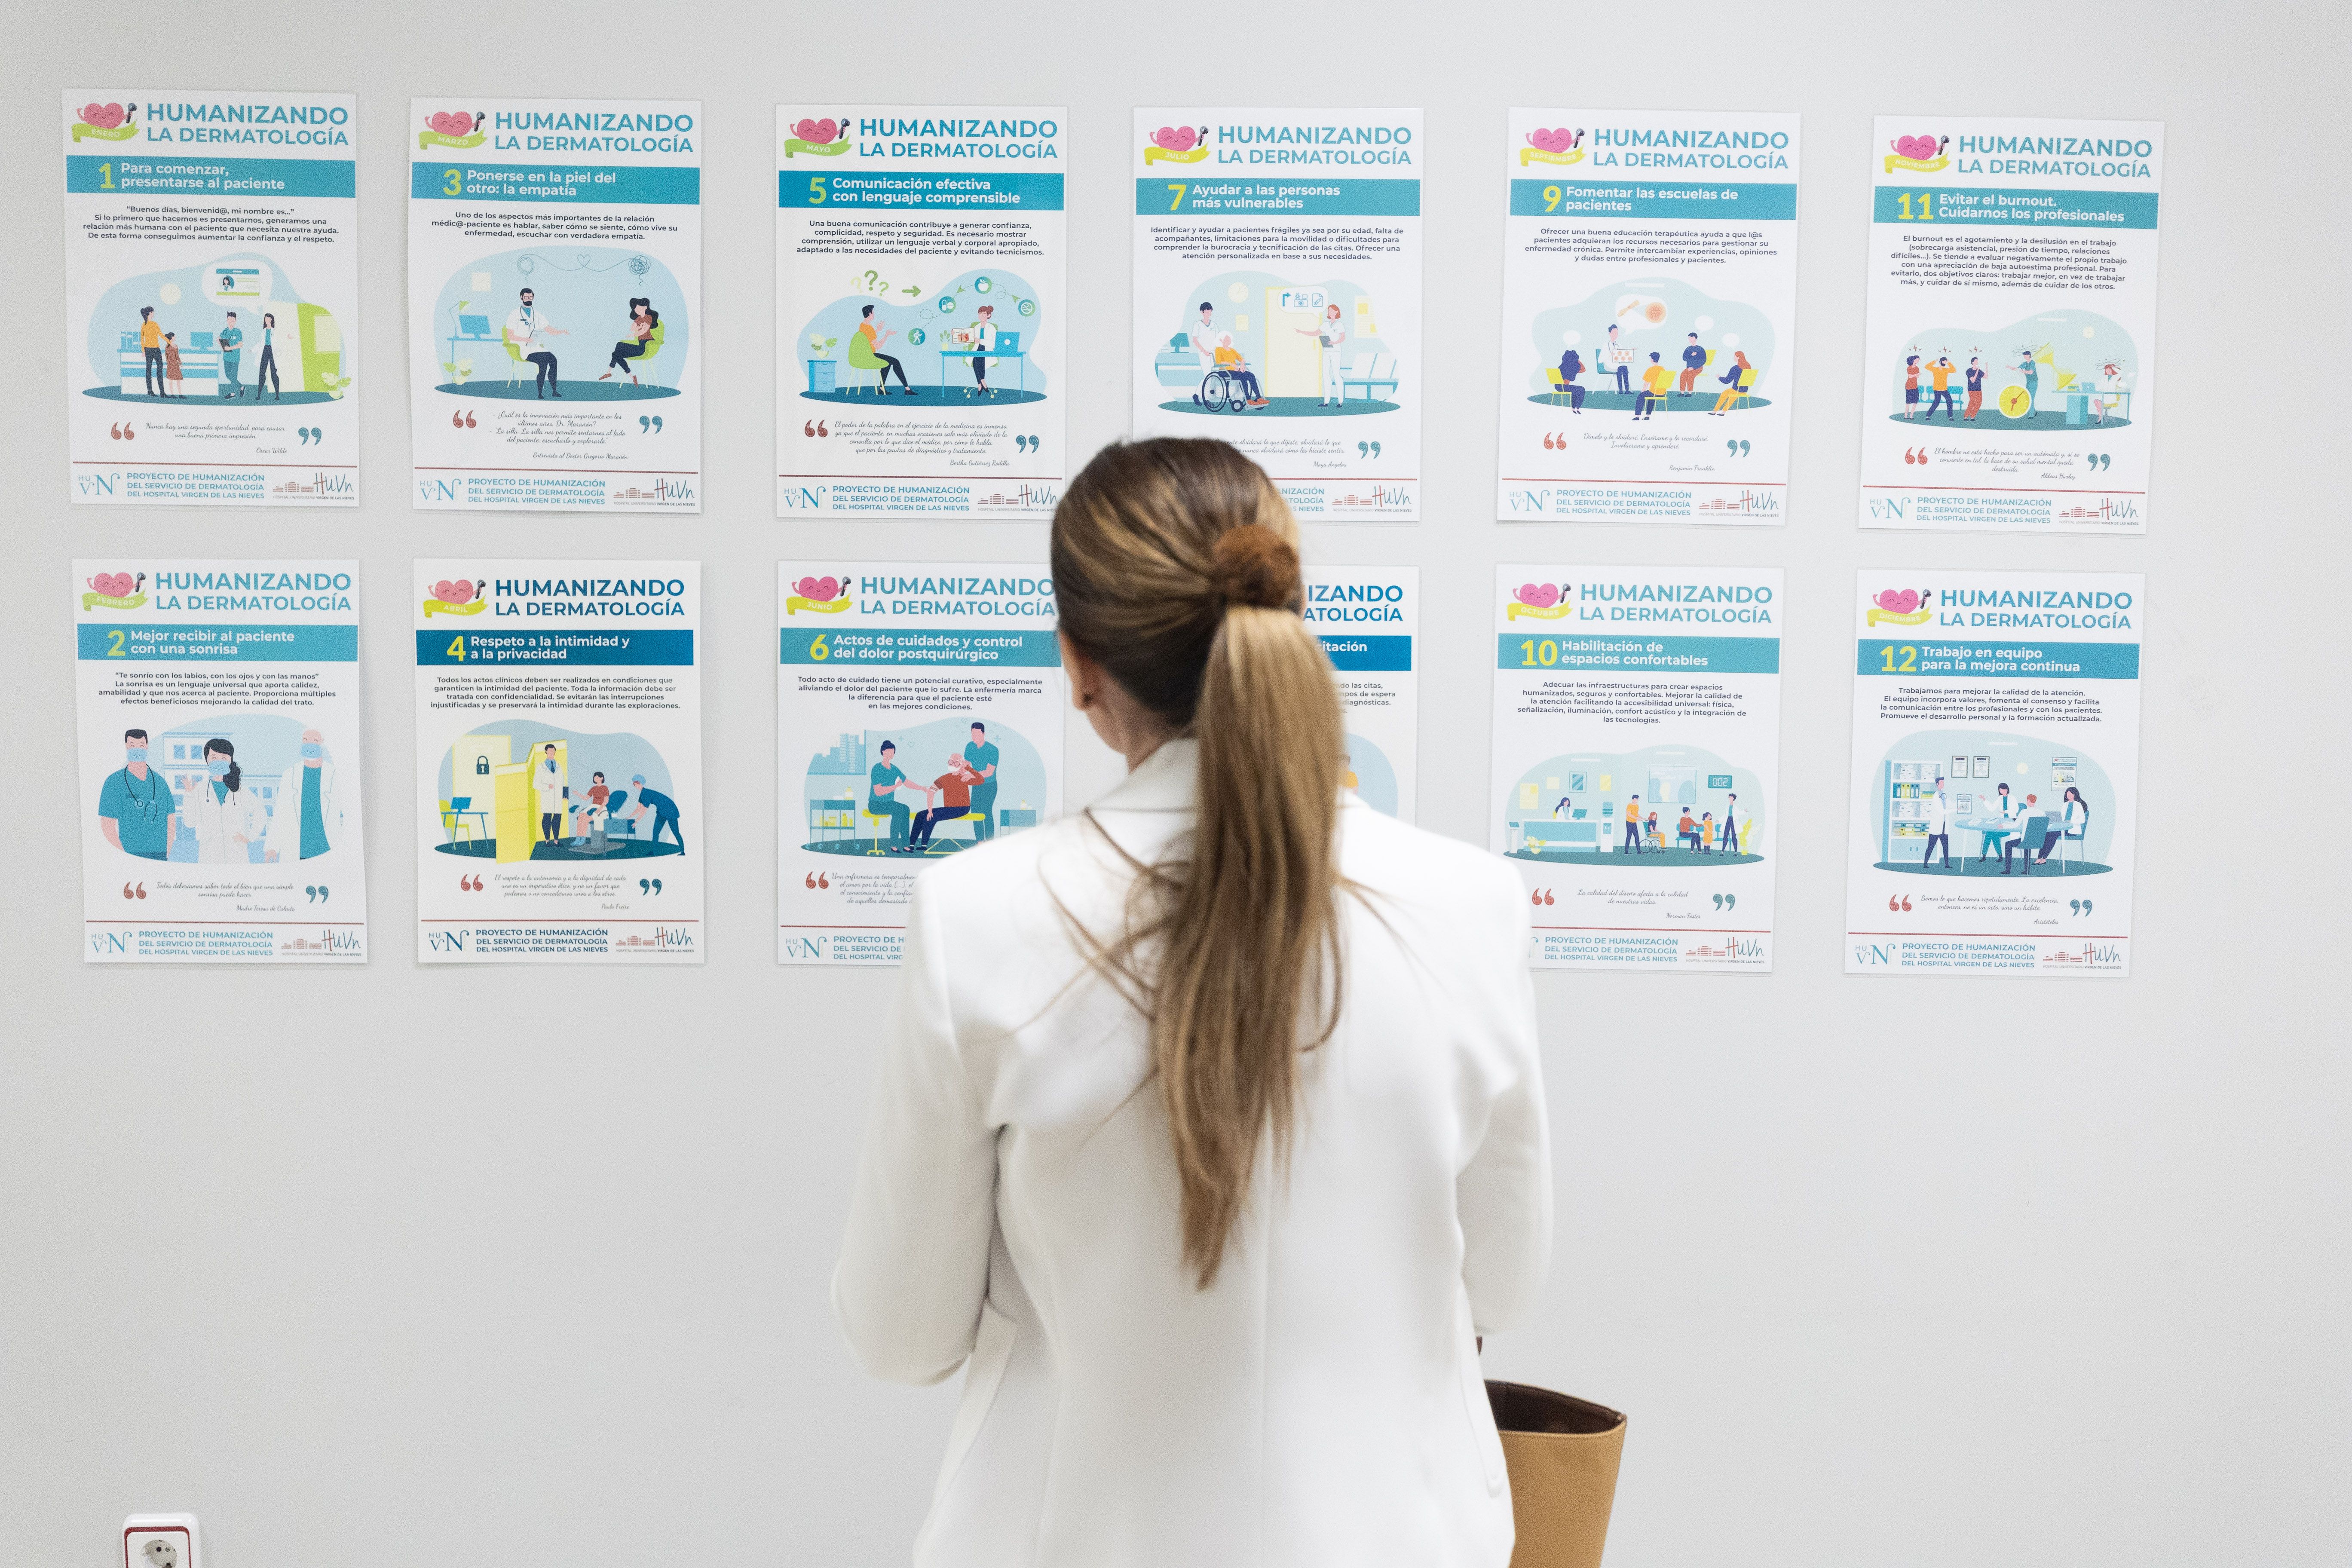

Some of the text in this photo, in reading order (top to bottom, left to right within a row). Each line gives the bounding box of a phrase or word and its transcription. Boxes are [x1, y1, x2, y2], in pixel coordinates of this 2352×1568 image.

[91, 128, 120, 138] ENERO
[860, 118, 1057, 138] HUMANIZANDO
[438, 136, 469, 146] MARZO
[806, 144, 831, 153] MAYO
[860, 140, 1057, 159] LA DERMATOLOGÍA
[1165, 151, 1190, 161] JULIO
[1530, 152, 1577, 162] SEPTIEMBRE
[121, 162, 229, 177] Para comenzar,
[1895, 159, 1940, 169] NOVIEMBRE
[99, 162, 116, 189] 1
[443, 168, 462, 196] 3
[467, 169, 616, 187] Ponerse en la piel del
[121, 177, 285, 191] presentarse al paciente
[466, 183, 577, 198] otro: la empatía
[808, 177, 827, 204] 5
[832, 177, 991, 190] Comunicación efectiva
[1192, 184, 1341, 198] Ayudar a las personas
[832, 190, 1021, 205] con lenguaje comprensible
[1168, 184, 1187, 211] 7
[1543, 185, 1562, 212] 9
[1566, 186, 1739, 200] Fomentar las escuelas de
[1939, 193, 2057, 207] Evitar el burnout.
[181, 206, 230, 215] bienvenid@,
[1192, 197, 1304, 209] más vulnerables
[1565, 199, 1632, 212] pacientes
[1897, 193, 1934, 220] 11
[1938, 205, 2125, 222] Cuidarnos los profesionales
[909, 221, 951, 230] contribuye
[1909, 244, 1954, 252] (sobrecarga
[1956, 245, 1998, 253] asistencial,
[2041, 246, 2070, 255] tiempo,
[96, 596, 135, 606] FEBRERO
[1308, 585, 1403, 603] IZANDO
[1941, 589, 2132, 609] HUMANIZANDO
[1302, 604, 1403, 622] ATOLOGÍA
[1521, 606, 1559, 617] OCTUBRE
[1879, 612, 1921, 622] DICIEMBRE
[1940, 611, 2132, 629] LA DERMATOLOGÍA
[107, 630, 126, 656] 2
[131, 629, 295, 644] Mejor recibir al paciente
[471, 635, 630, 649] Respeto a la intimidad y
[833, 634, 1023, 649] Actos de cuidados y control
[130, 643, 238, 655] con una sonrisa
[447, 635, 466, 662] 4
[809, 634, 829, 661] 6
[1316, 640, 1368, 652] itación
[1521, 640, 1558, 666] 10
[1562, 640, 1663, 652] Habilitación de
[470, 647, 567, 662] a la privacidad
[833, 646, 999, 662] del dolor postquirúrgico
[1561, 652, 1708, 666] espacios confortables
[1880, 646, 1917, 672] 12
[1921, 646, 2043, 662] Trabajo en equipo
[1921, 658, 2080, 673] para la mejora continua
[1615, 717, 1661, 725] tecnologías.
[1902, 942, 1950, 950] PROYECTO
[1966, 943, 2036, 952] HUMANIZACIÓN
